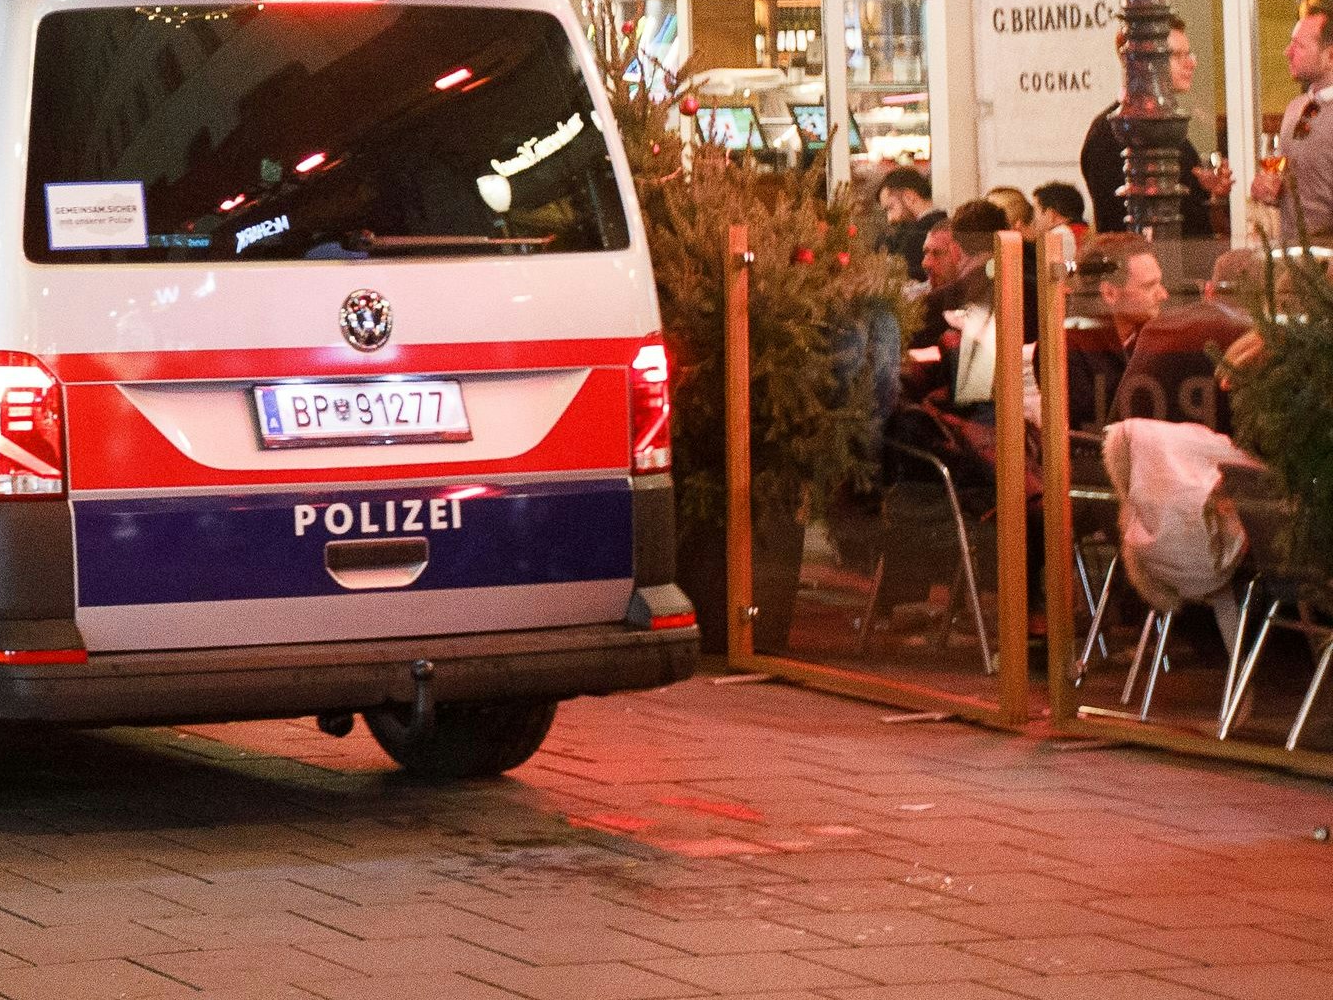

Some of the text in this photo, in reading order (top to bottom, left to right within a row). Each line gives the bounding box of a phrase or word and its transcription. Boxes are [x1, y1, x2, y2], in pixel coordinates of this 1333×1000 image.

[1020, 71, 1092, 92] COGNAC
[59, 216, 73, 226] mit
[74, 217, 106, 226] unserer
[292, 390, 443, 428] BP 91277
[294, 497, 462, 537] POLIZEI
